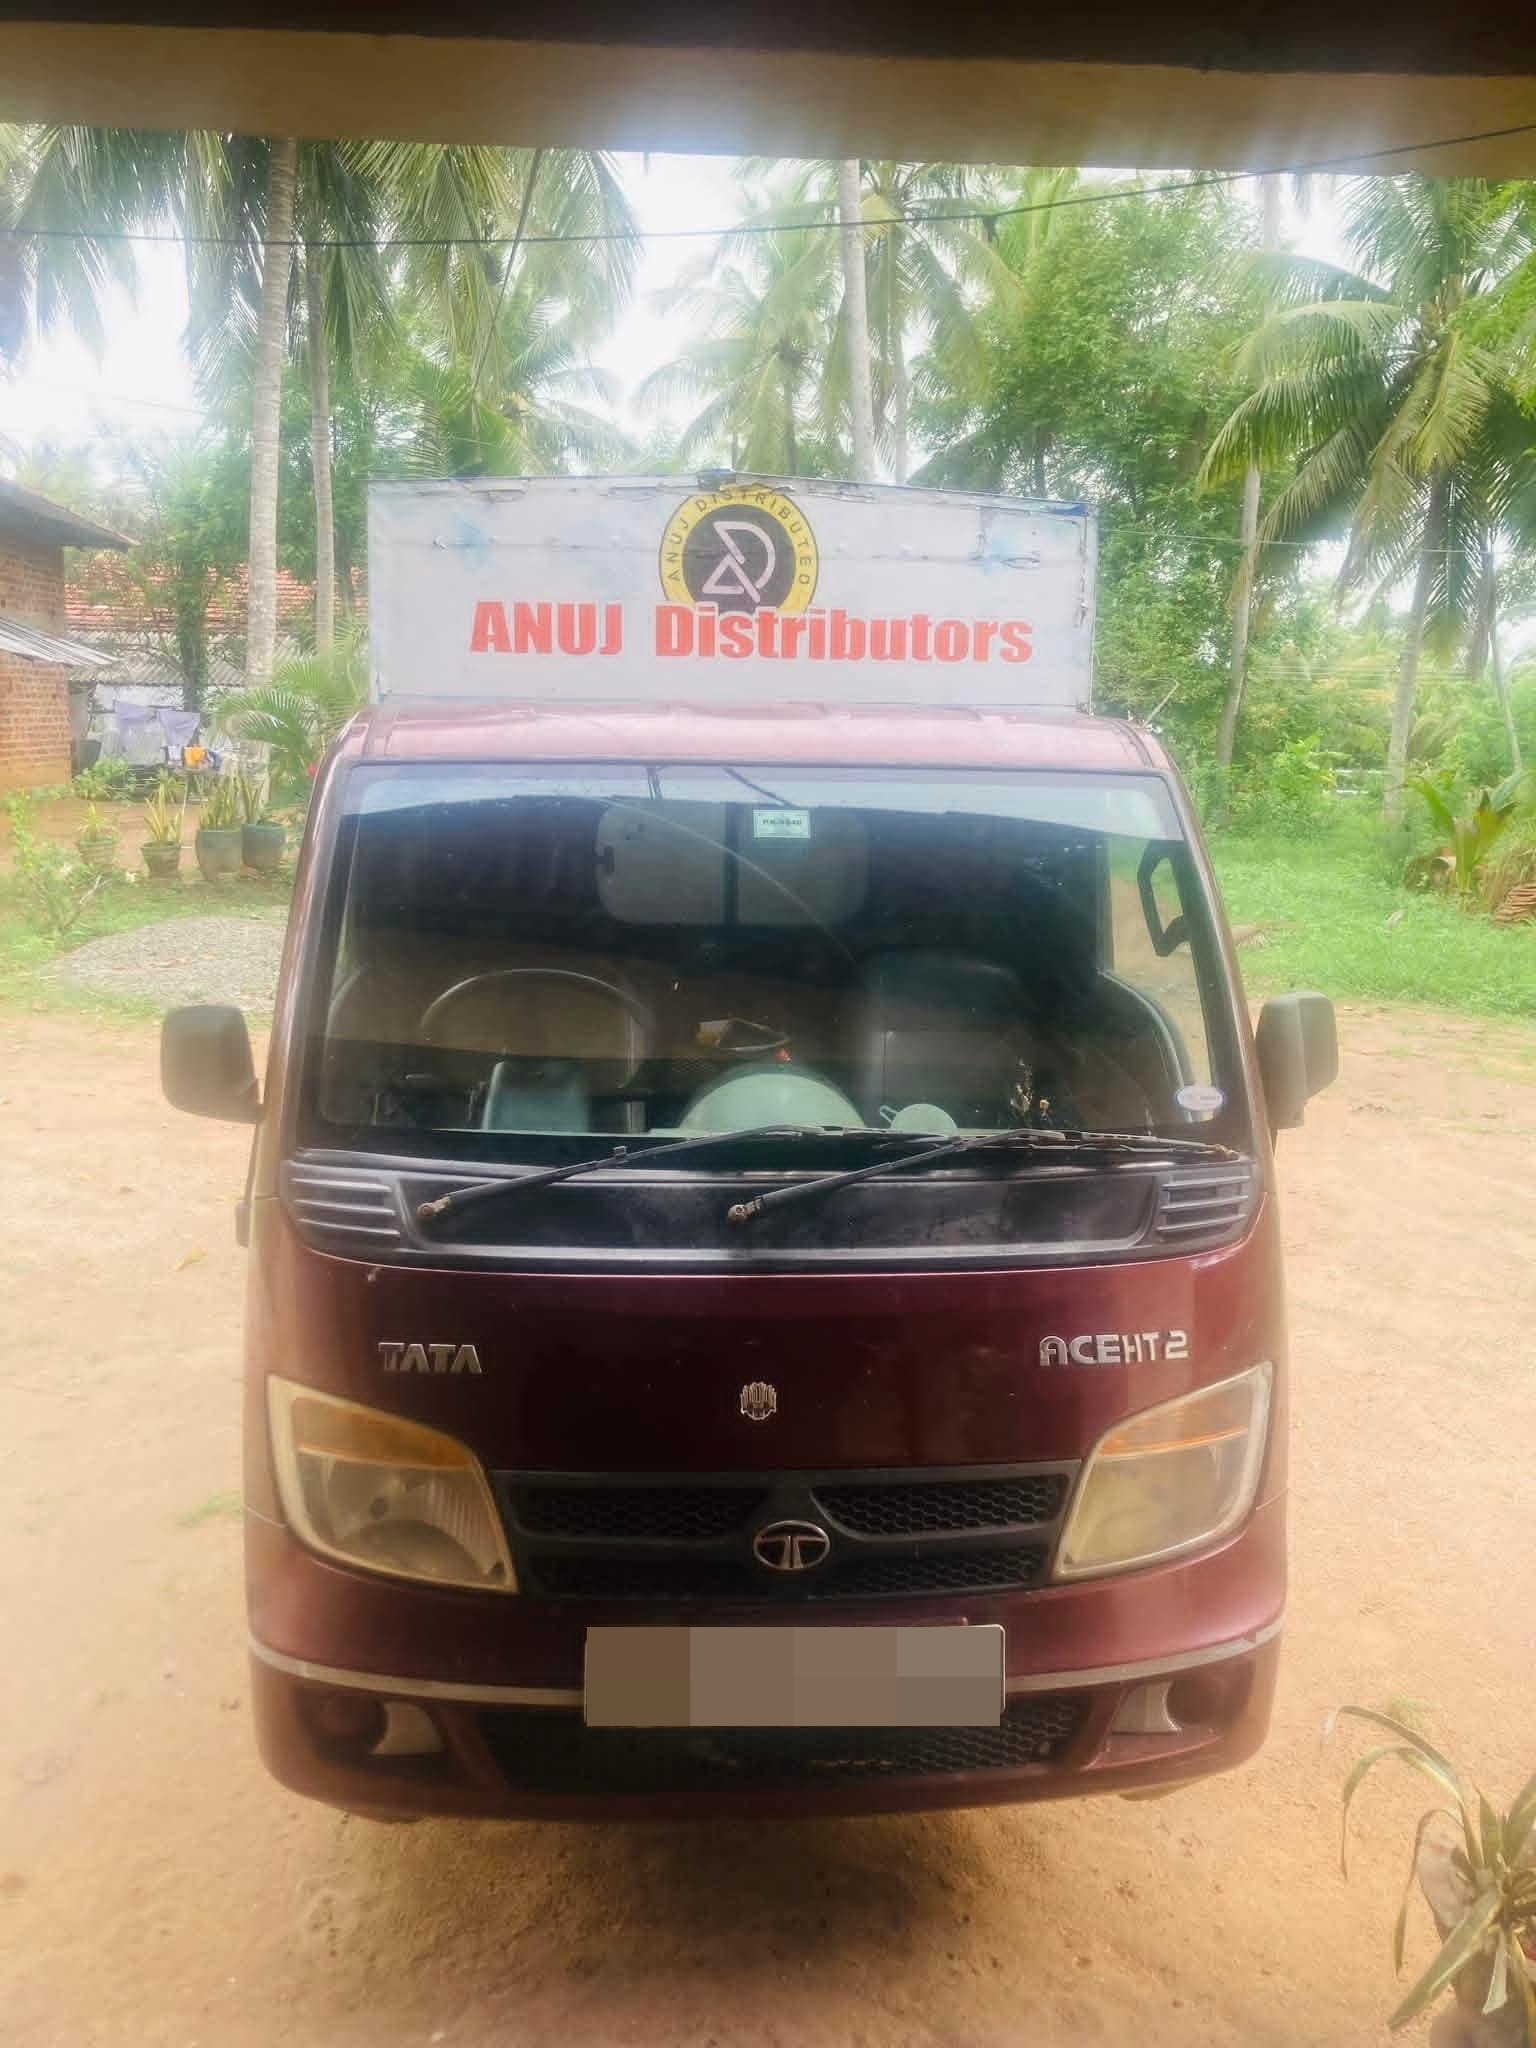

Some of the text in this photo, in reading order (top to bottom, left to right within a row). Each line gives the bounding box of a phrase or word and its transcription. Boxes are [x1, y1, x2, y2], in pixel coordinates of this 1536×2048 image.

[664, 517, 690, 582] ANUJ
[470, 601, 1033, 663] ANUJ Distributors
[378, 1342, 482, 1373] TATA
